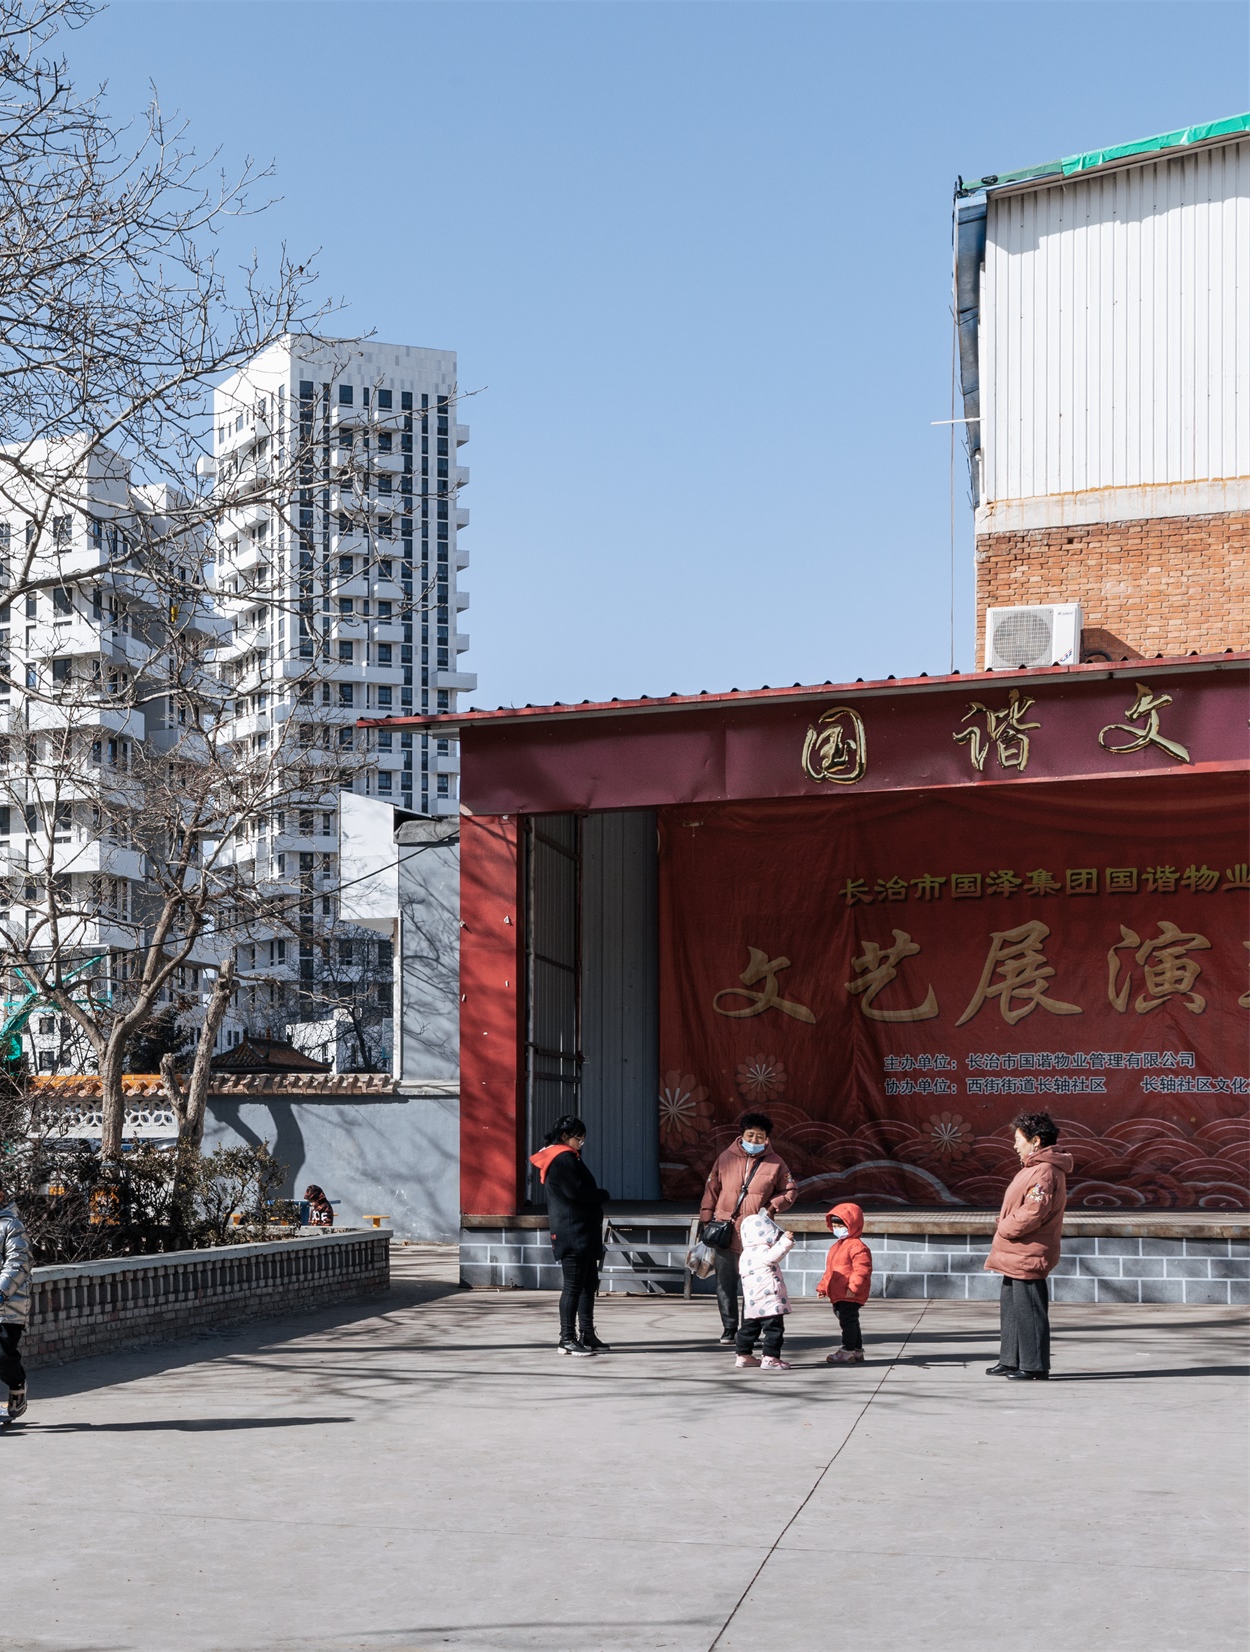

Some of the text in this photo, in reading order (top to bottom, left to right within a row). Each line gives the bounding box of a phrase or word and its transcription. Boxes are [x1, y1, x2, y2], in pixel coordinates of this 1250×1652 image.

[801, 683, 1190, 785] 国谐文
[839, 863, 1250, 906] 长治市国泽集团国谐物业
[713, 920, 1250, 1027] 文艺展演
[1141, 1076, 1250, 1094] 长轴社区文化
